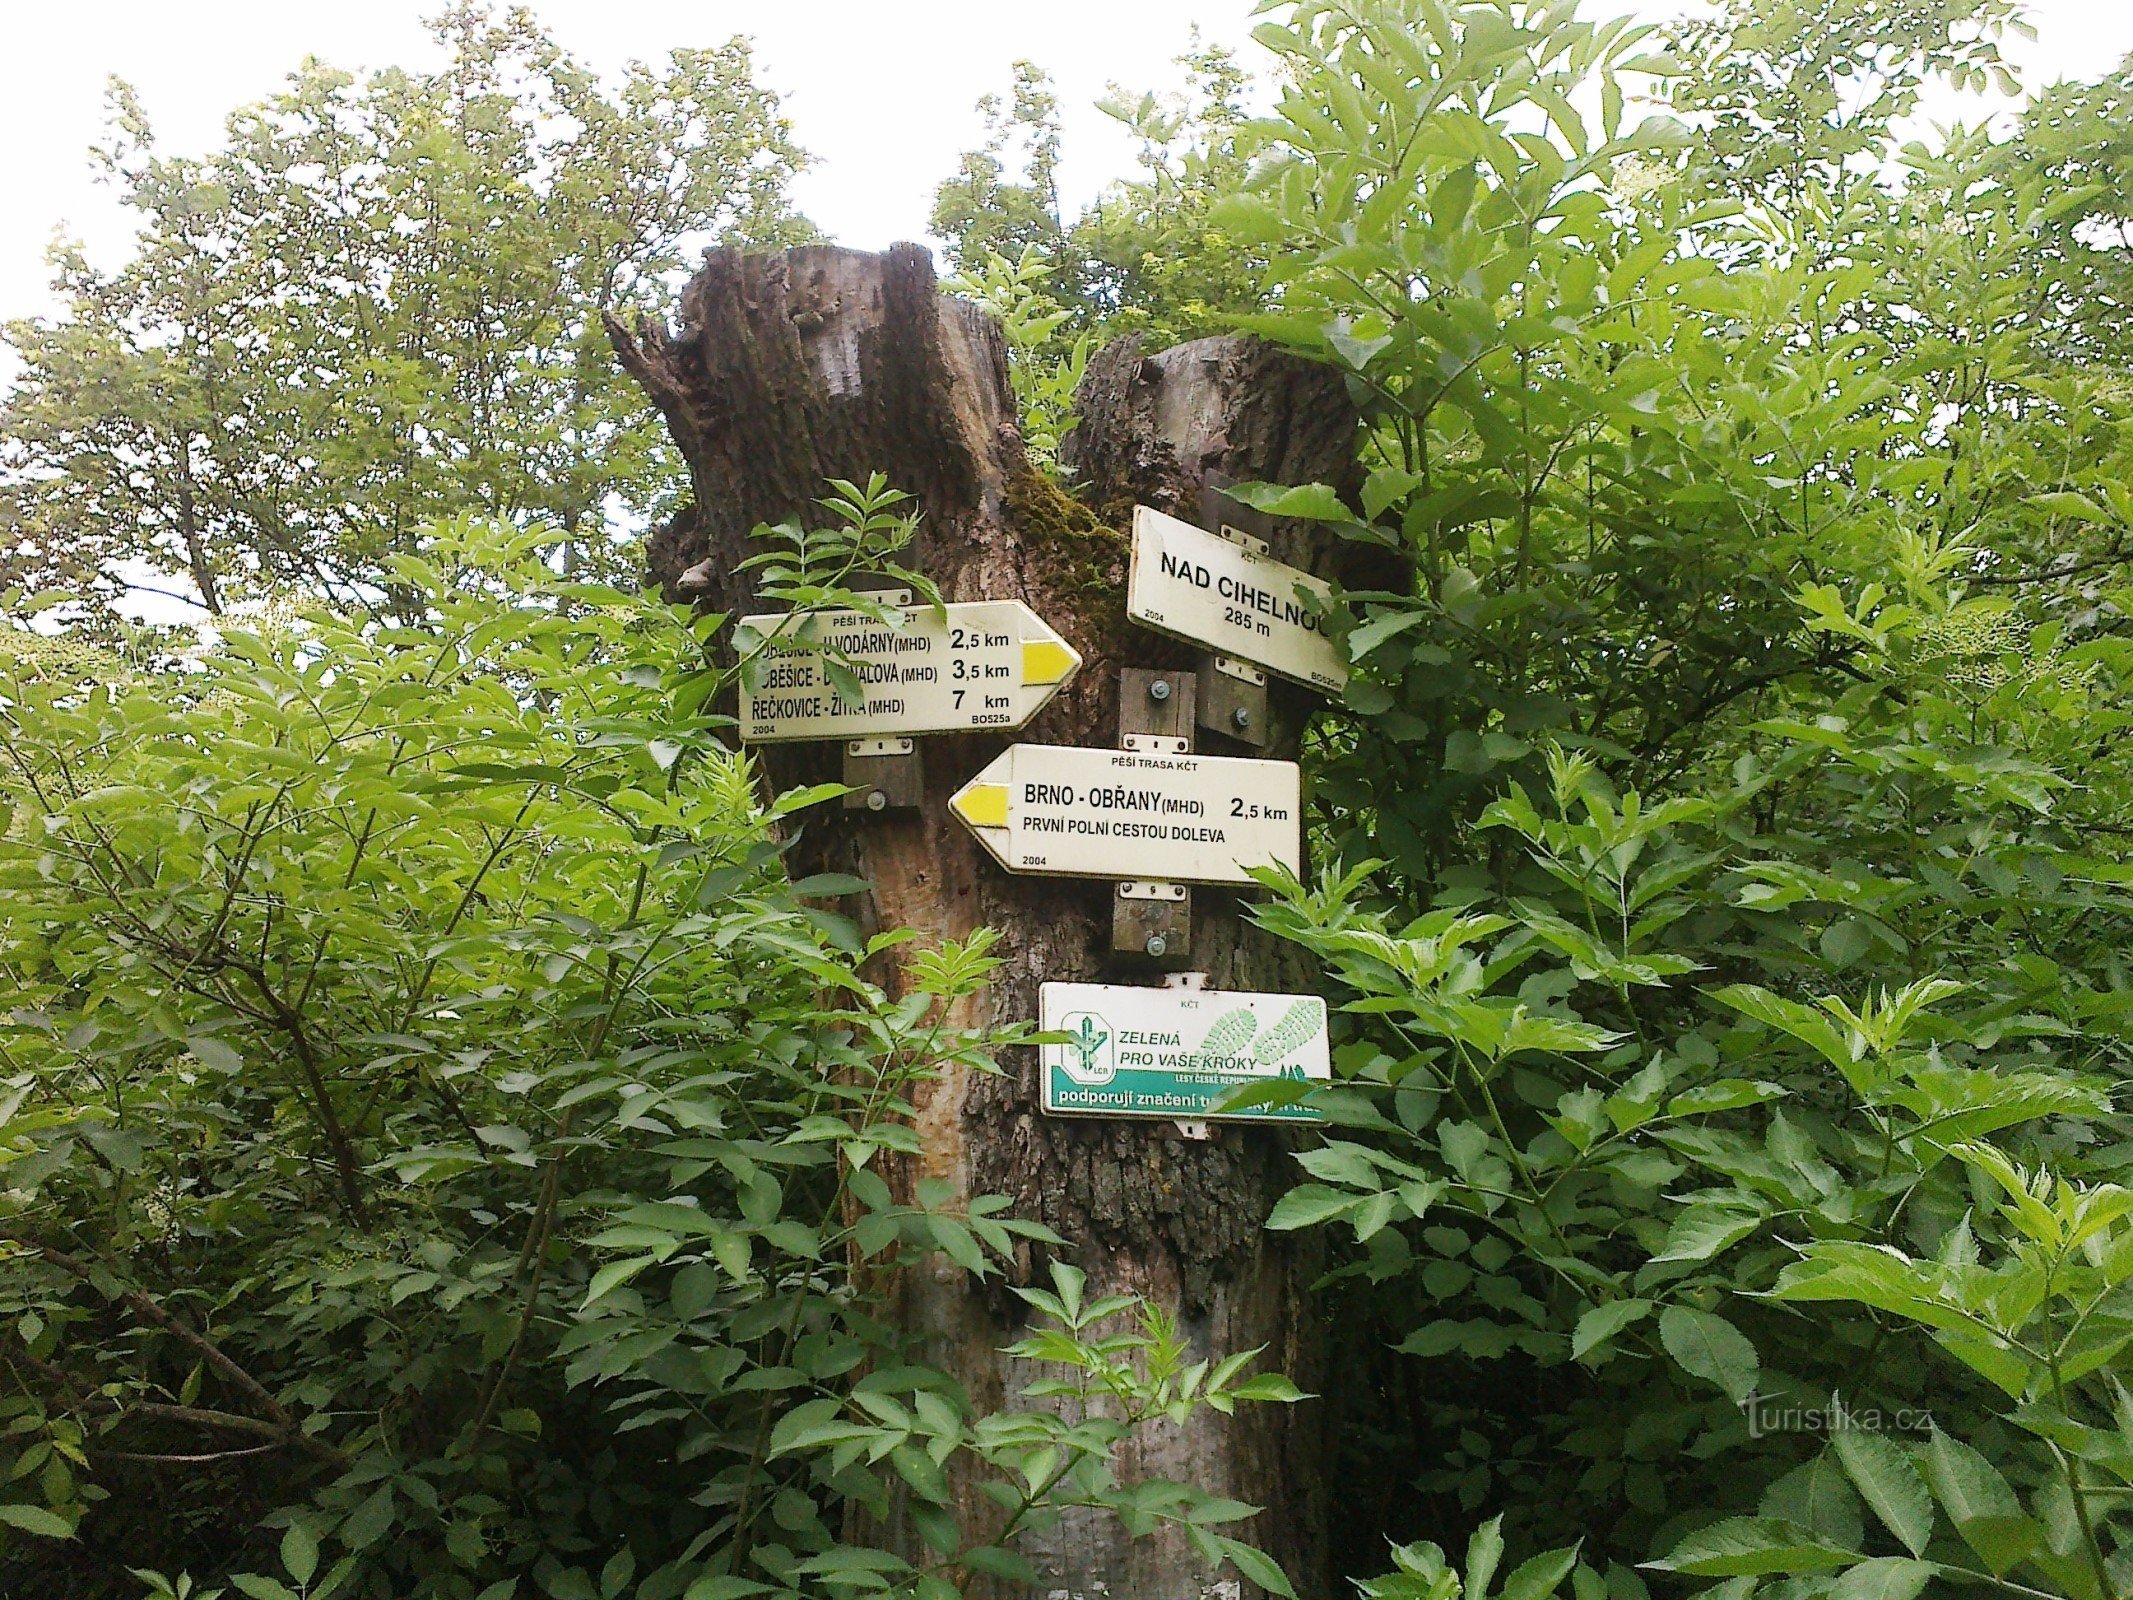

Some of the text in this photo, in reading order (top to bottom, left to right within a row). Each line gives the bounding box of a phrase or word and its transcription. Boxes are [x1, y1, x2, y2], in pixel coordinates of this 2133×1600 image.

[1160, 551, 1210, 588] NAD
[833, 615, 856, 627] PĚŠÍ
[1145, 608, 1164, 622] 2004
[1224, 606, 1270, 637] 285 m
[951, 629, 1009, 650] 2,5 km
[952, 659, 1009, 681] 3,5 km
[752, 695, 821, 720] ŘEČKOVICE
[952, 690, 1009, 710] 7 km
[1112, 756, 1198, 772] PĚŠÍ TRASA KČT
[1025, 783, 1073, 806] BRNO
[1230, 798, 1288, 820] 2,5 km
[1023, 815, 1226, 843] PRVNÍ POLNÍ CESTOU DOLEVA
[1022, 856, 1047, 866] 2004
[1119, 1030, 1181, 1047] ZELENÁ
[1119, 1051, 1258, 1071] PRO VAŠE KROKY
[1058, 1088, 1133, 1108] podporují
[1137, 1090, 1196, 1106] značení
